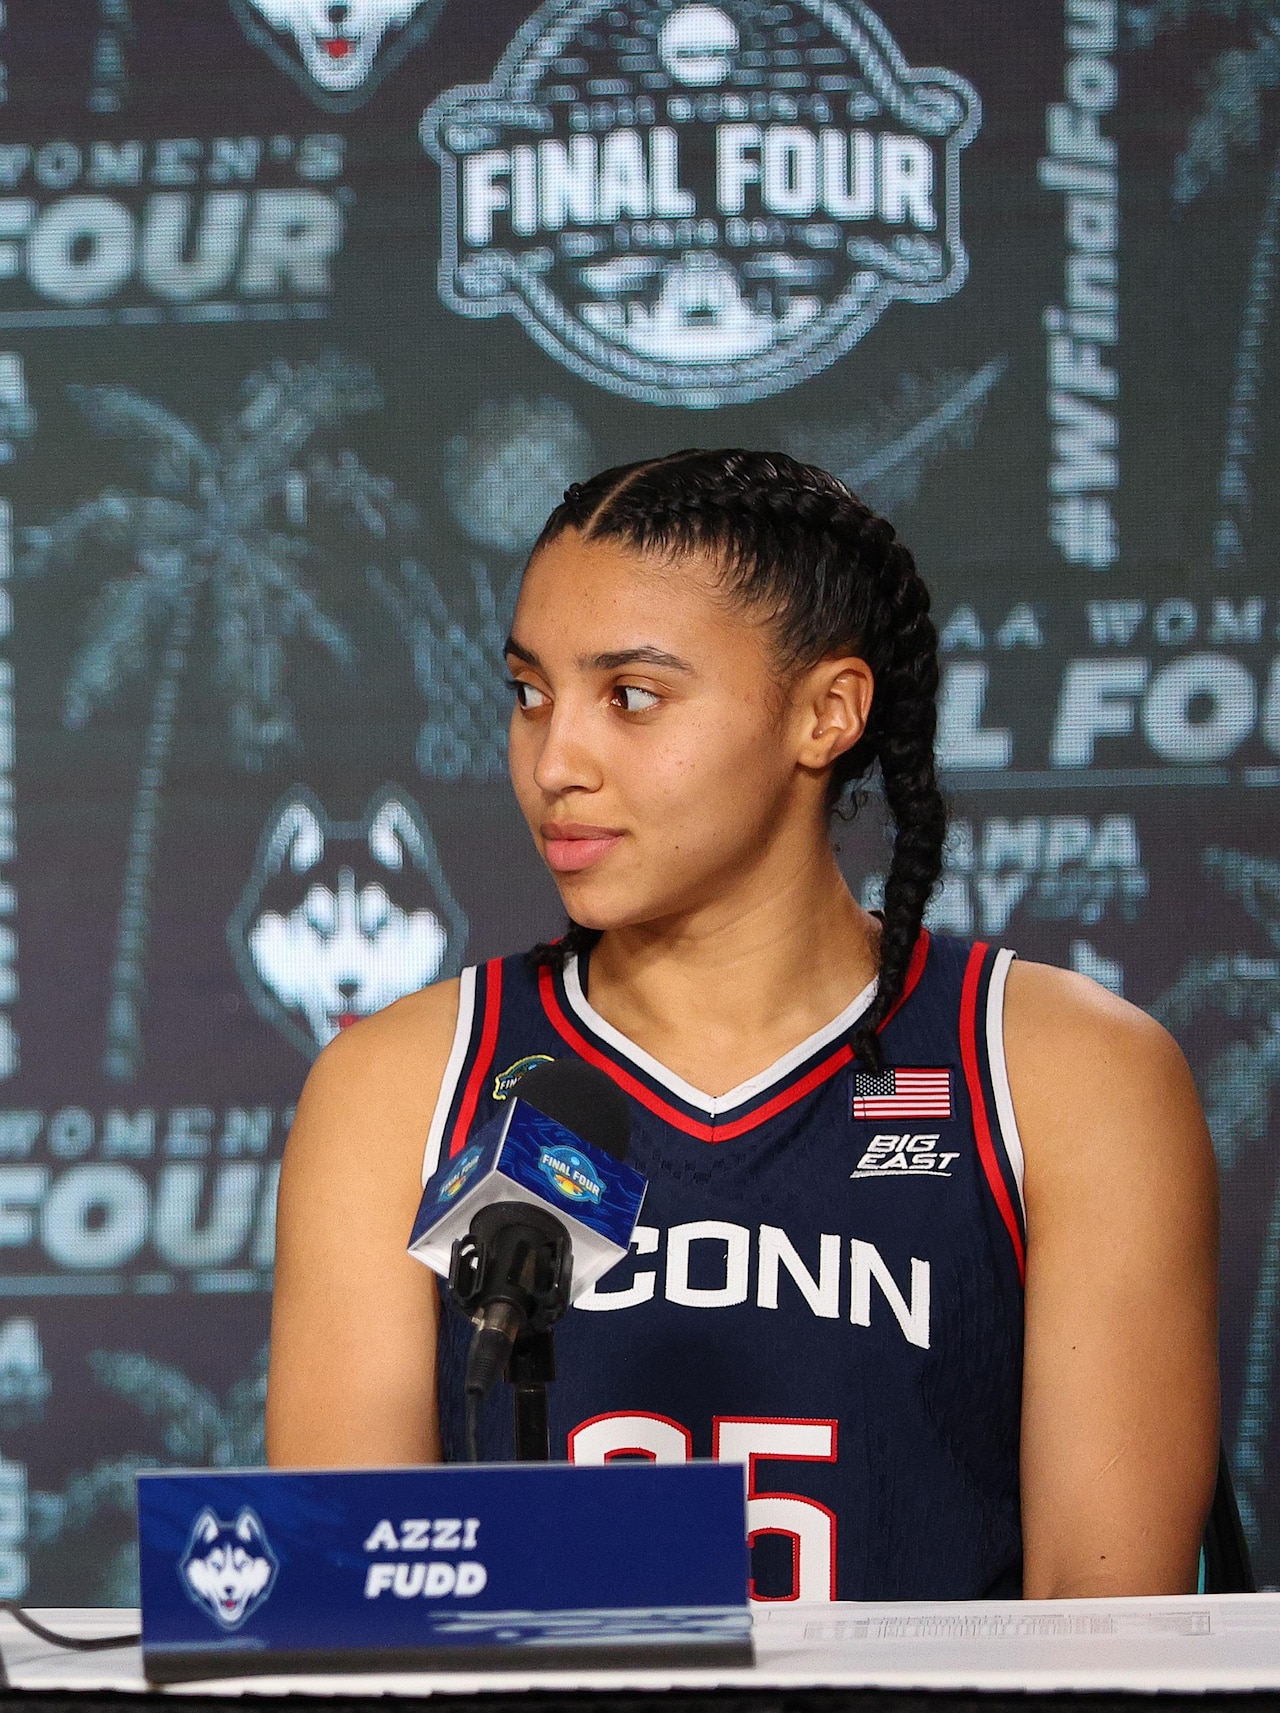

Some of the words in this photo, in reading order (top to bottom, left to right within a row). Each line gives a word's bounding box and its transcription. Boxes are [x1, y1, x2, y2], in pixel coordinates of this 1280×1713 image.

[461, 124, 697, 247] FINAL
[715, 121, 939, 233] FOUR
[1037, 0, 1120, 570] #WFinalFou
[856, 1152, 961, 1170] EAST
[866, 1133, 941, 1154] BIG
[541, 1153, 571, 1177] FINAL
[572, 1171, 601, 1197] FOUR
[572, 1220, 931, 1349] CONN
[363, 1516, 481, 1553] AZZI
[363, 1561, 488, 1600] FUDD
